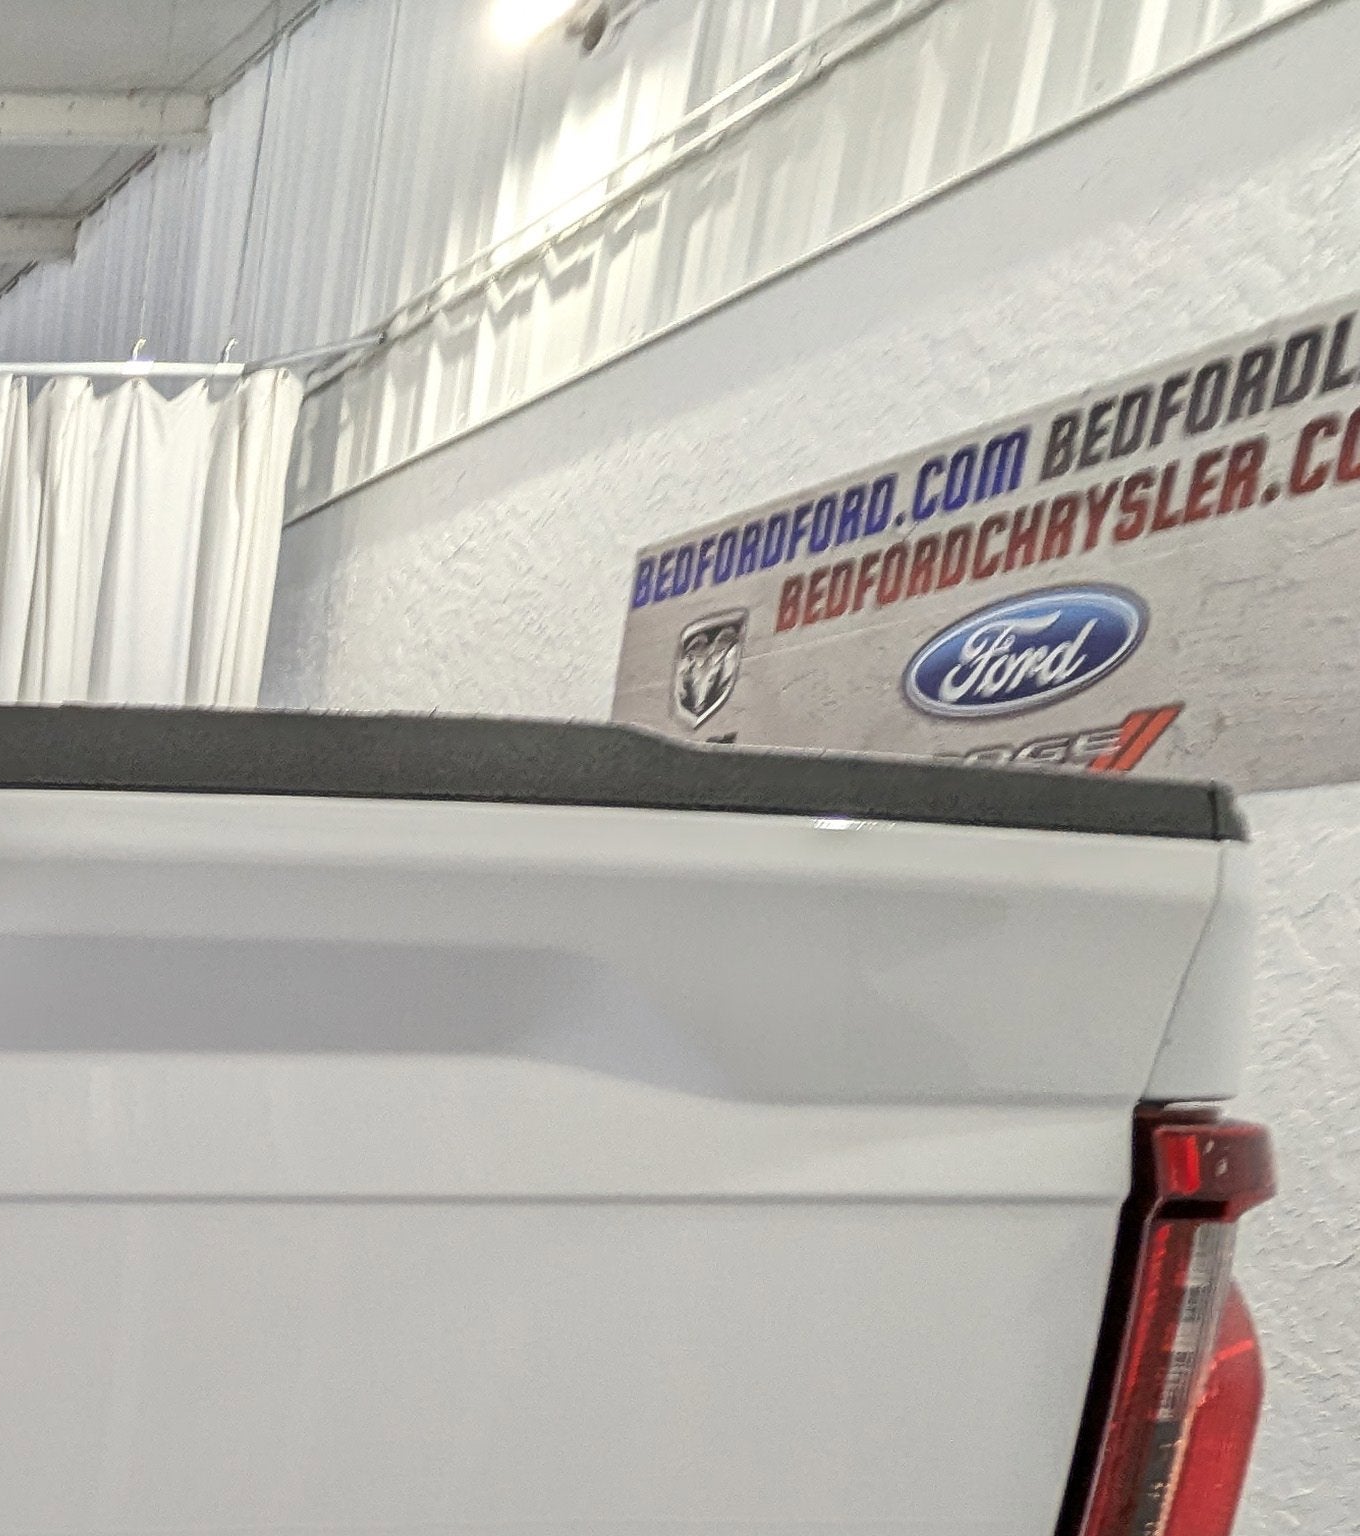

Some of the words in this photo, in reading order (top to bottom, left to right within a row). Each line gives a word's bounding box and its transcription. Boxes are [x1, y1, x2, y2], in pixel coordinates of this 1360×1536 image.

[632, 427, 1033, 610] BEDFORDFORD.COM
[1038, 308, 1360, 483] BEDFORDL
[938, 610, 1098, 703] Ford
